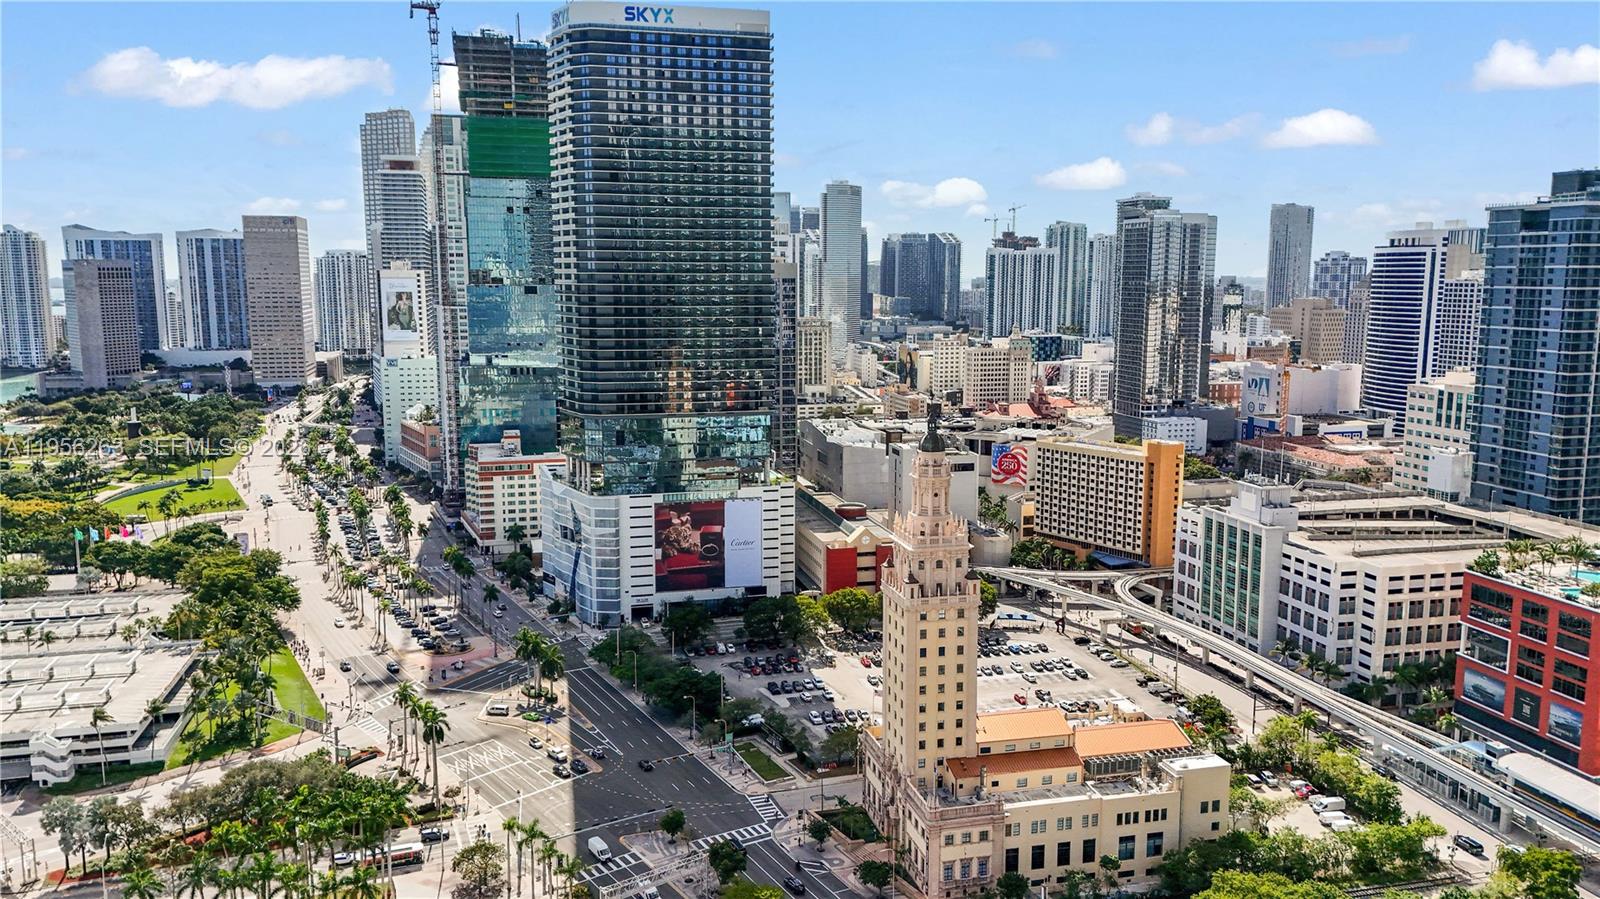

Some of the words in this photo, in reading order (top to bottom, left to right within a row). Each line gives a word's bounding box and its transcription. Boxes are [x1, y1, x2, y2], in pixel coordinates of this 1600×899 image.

[624, 6, 674, 24] SKYX
[1001, 461, 1018, 470] 250
[730, 538, 755, 547] Cartier
